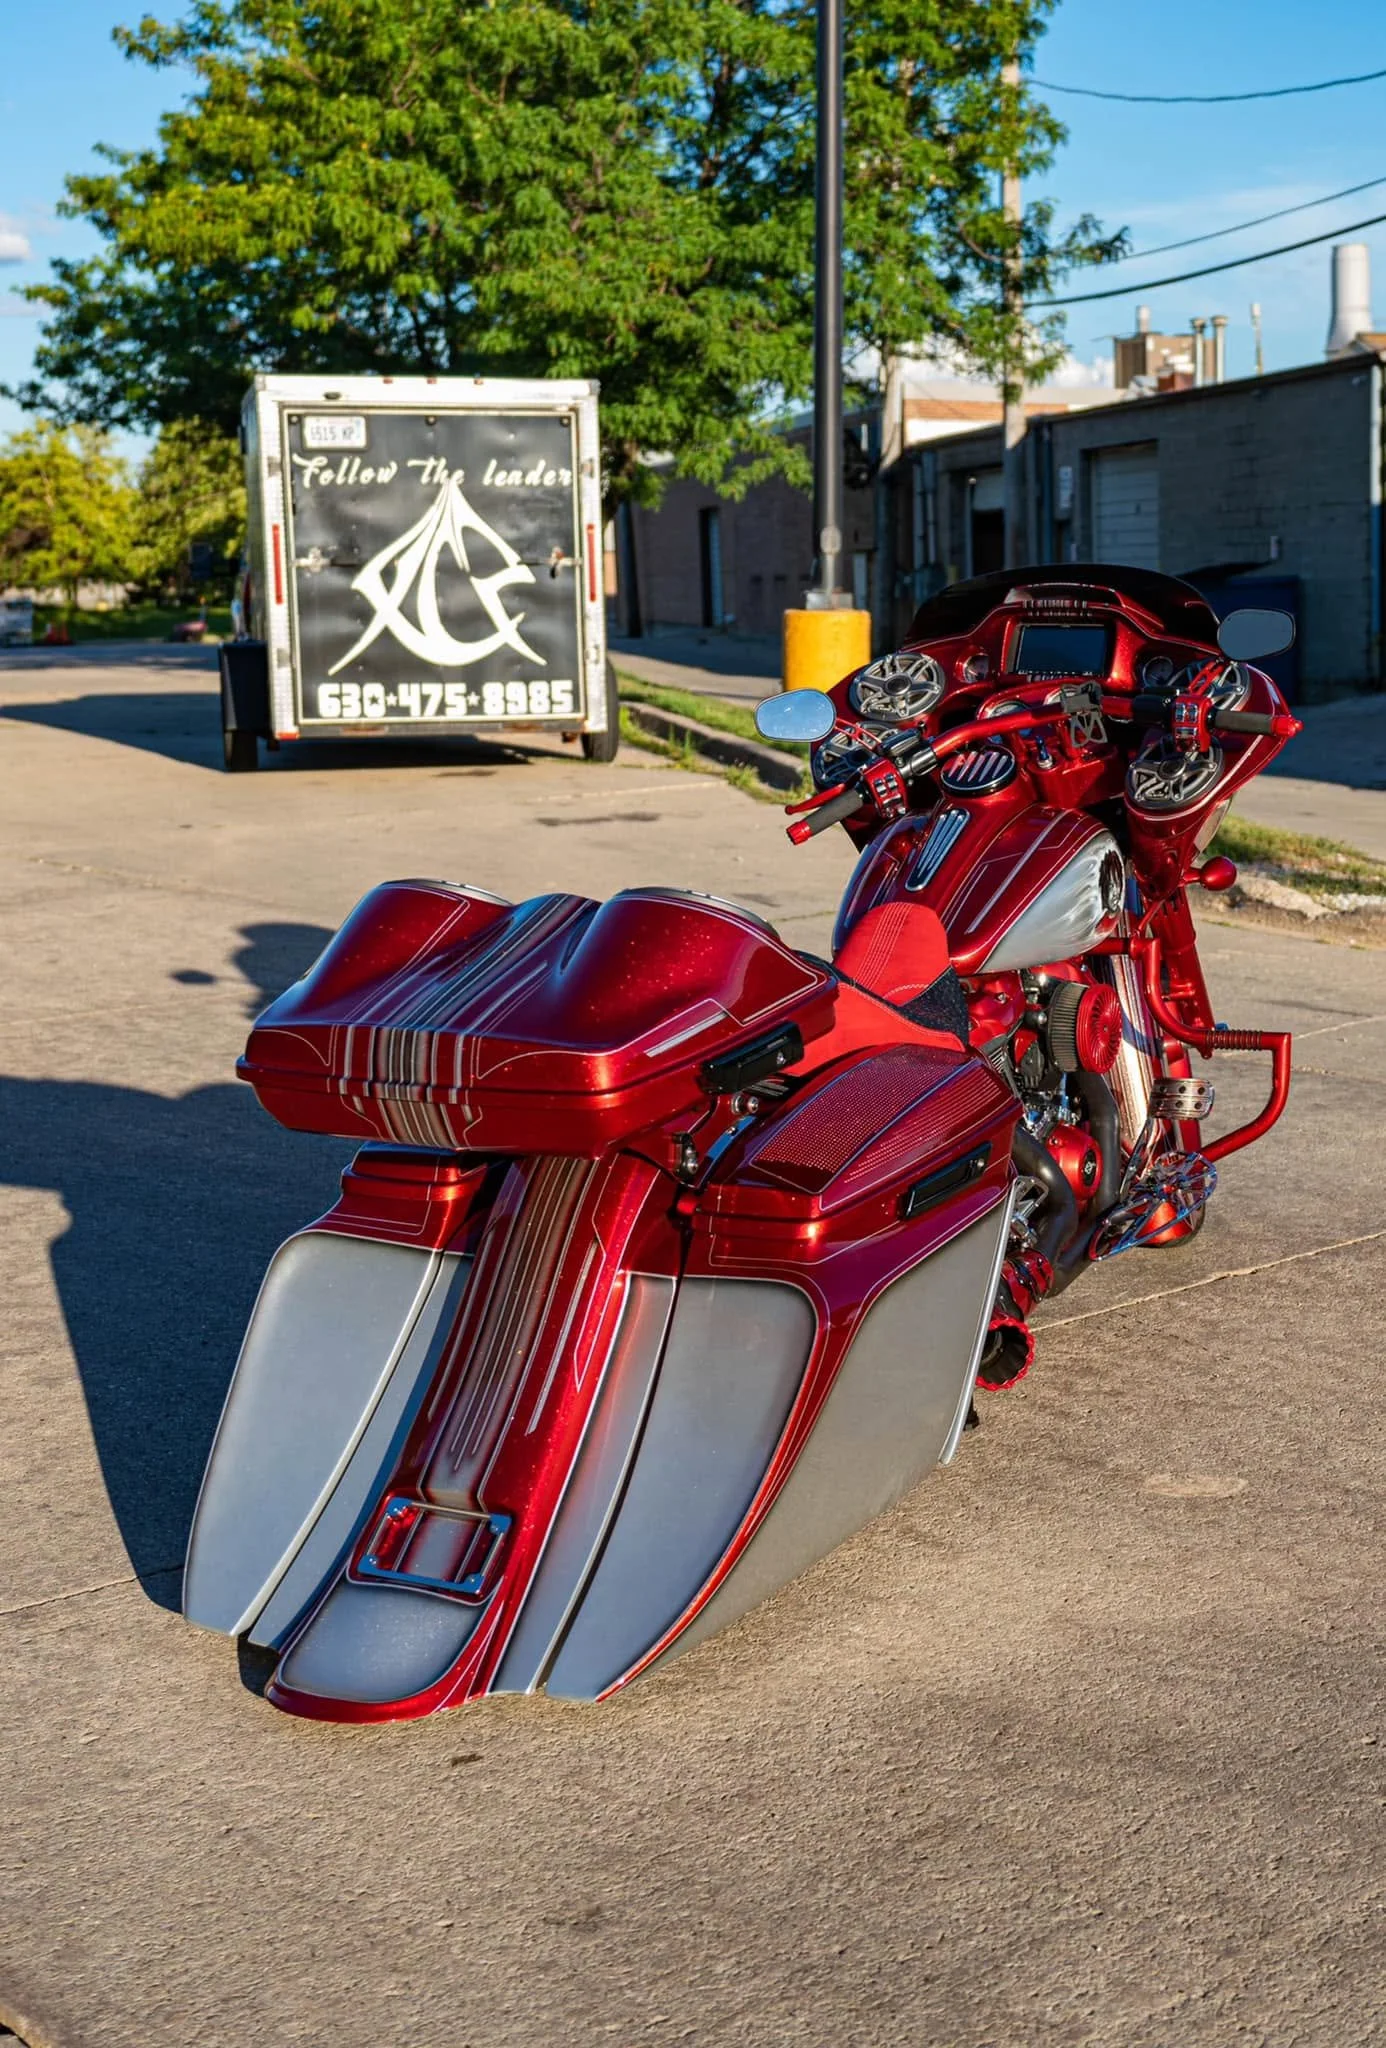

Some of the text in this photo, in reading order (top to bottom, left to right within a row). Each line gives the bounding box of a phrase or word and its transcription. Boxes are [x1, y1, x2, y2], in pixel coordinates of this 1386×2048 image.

[292, 452, 398, 489] Follow
[483, 458, 572, 486] leader
[397, 682, 468, 718] 475
[482, 680, 573, 715] 8985
